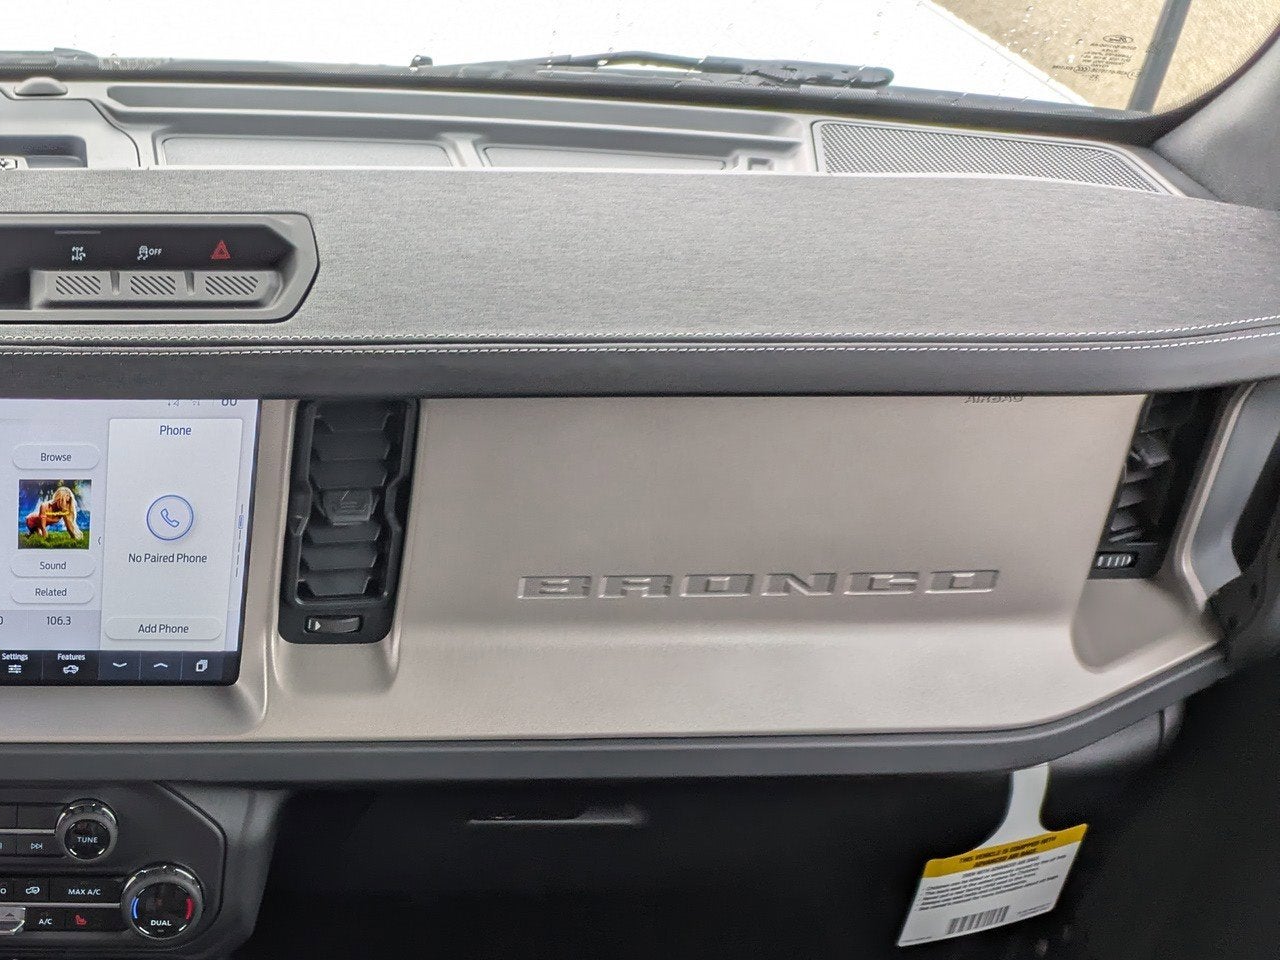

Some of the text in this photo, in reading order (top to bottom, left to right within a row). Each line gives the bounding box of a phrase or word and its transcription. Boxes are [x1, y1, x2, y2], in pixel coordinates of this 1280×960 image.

[148, 248, 163, 256] OFF
[159, 425, 192, 436] Phone
[40, 452, 72, 462] Browse
[128, 553, 208, 564] No Paired Phone
[39, 561, 67, 571] Sound
[518, 569, 1000, 599] BRONCO
[35, 587, 68, 597] Related
[46, 616, 71, 626] 106.3
[138, 624, 189, 634] Add Phone
[1, 652, 28, 662] Settings
[57, 653, 85, 661] Features
[77, 836, 98, 844] TUNE
[87, 888, 101, 896] A/C
[38, 918, 53, 926] A/C
